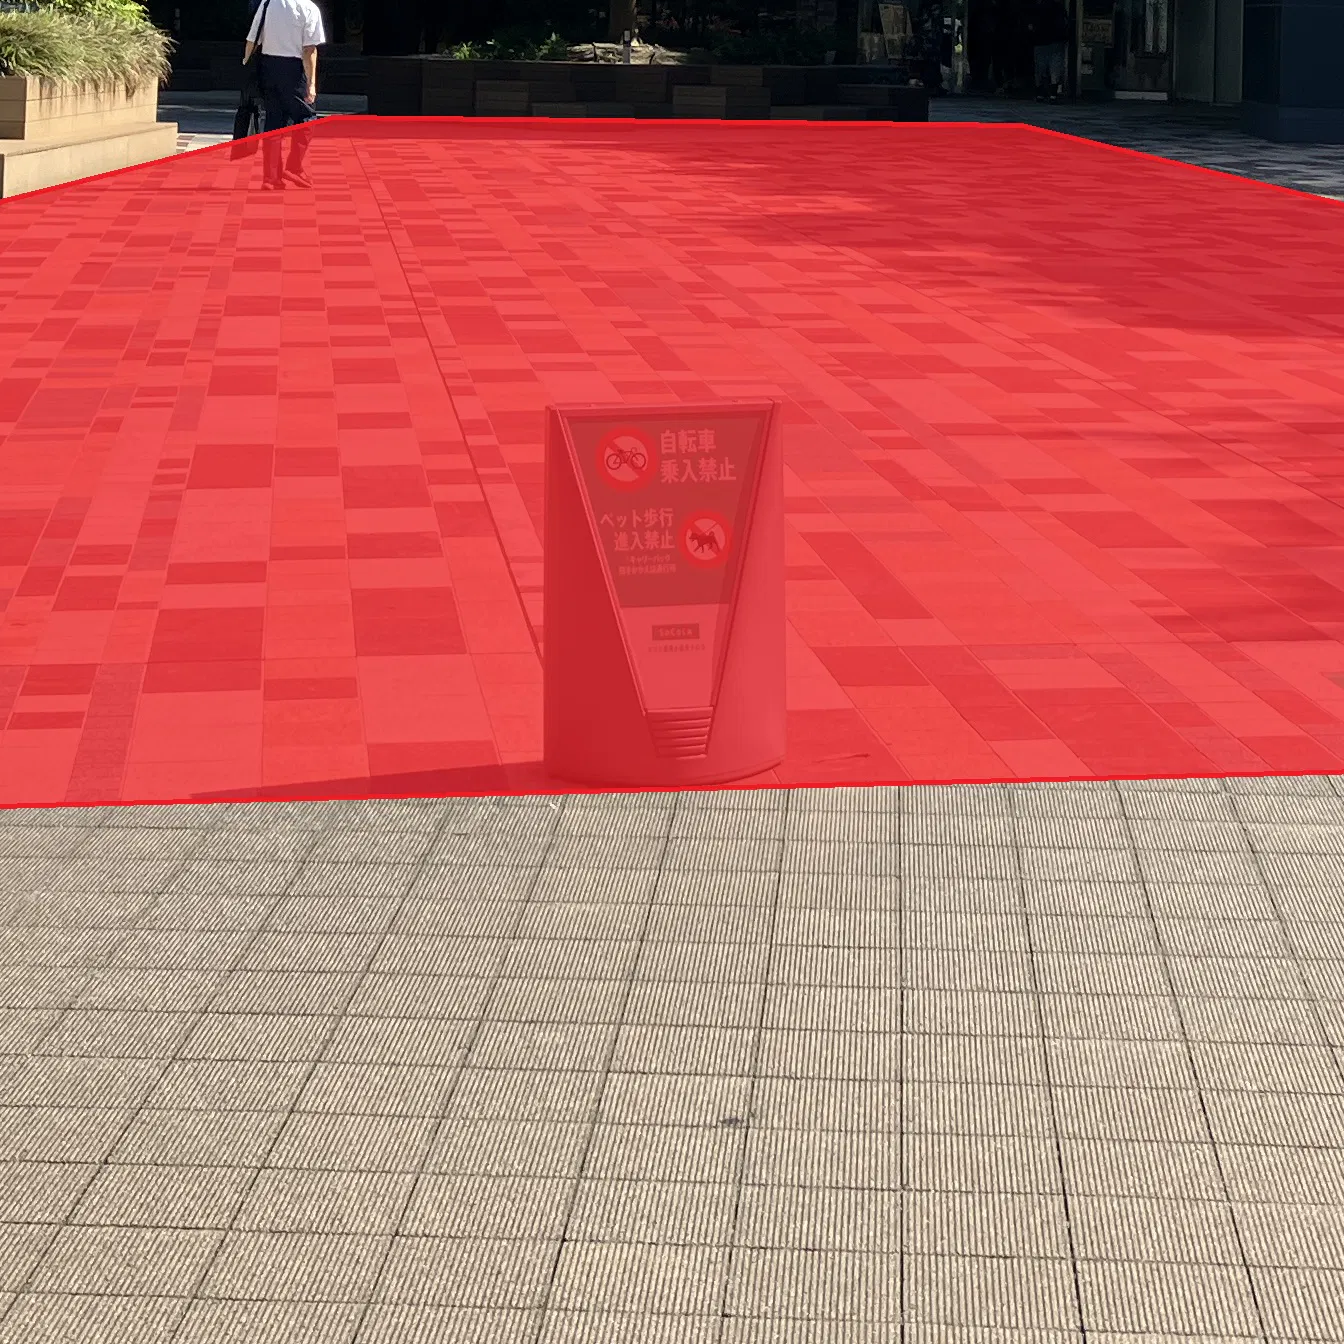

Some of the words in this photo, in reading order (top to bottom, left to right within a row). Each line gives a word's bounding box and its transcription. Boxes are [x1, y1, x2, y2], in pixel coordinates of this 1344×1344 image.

[660, 428, 716, 454] 自転車
[660, 457, 737, 484] 乗入禁止
[600, 508, 674, 528] ペット歩行
[614, 530, 675, 551] 進入禁止
